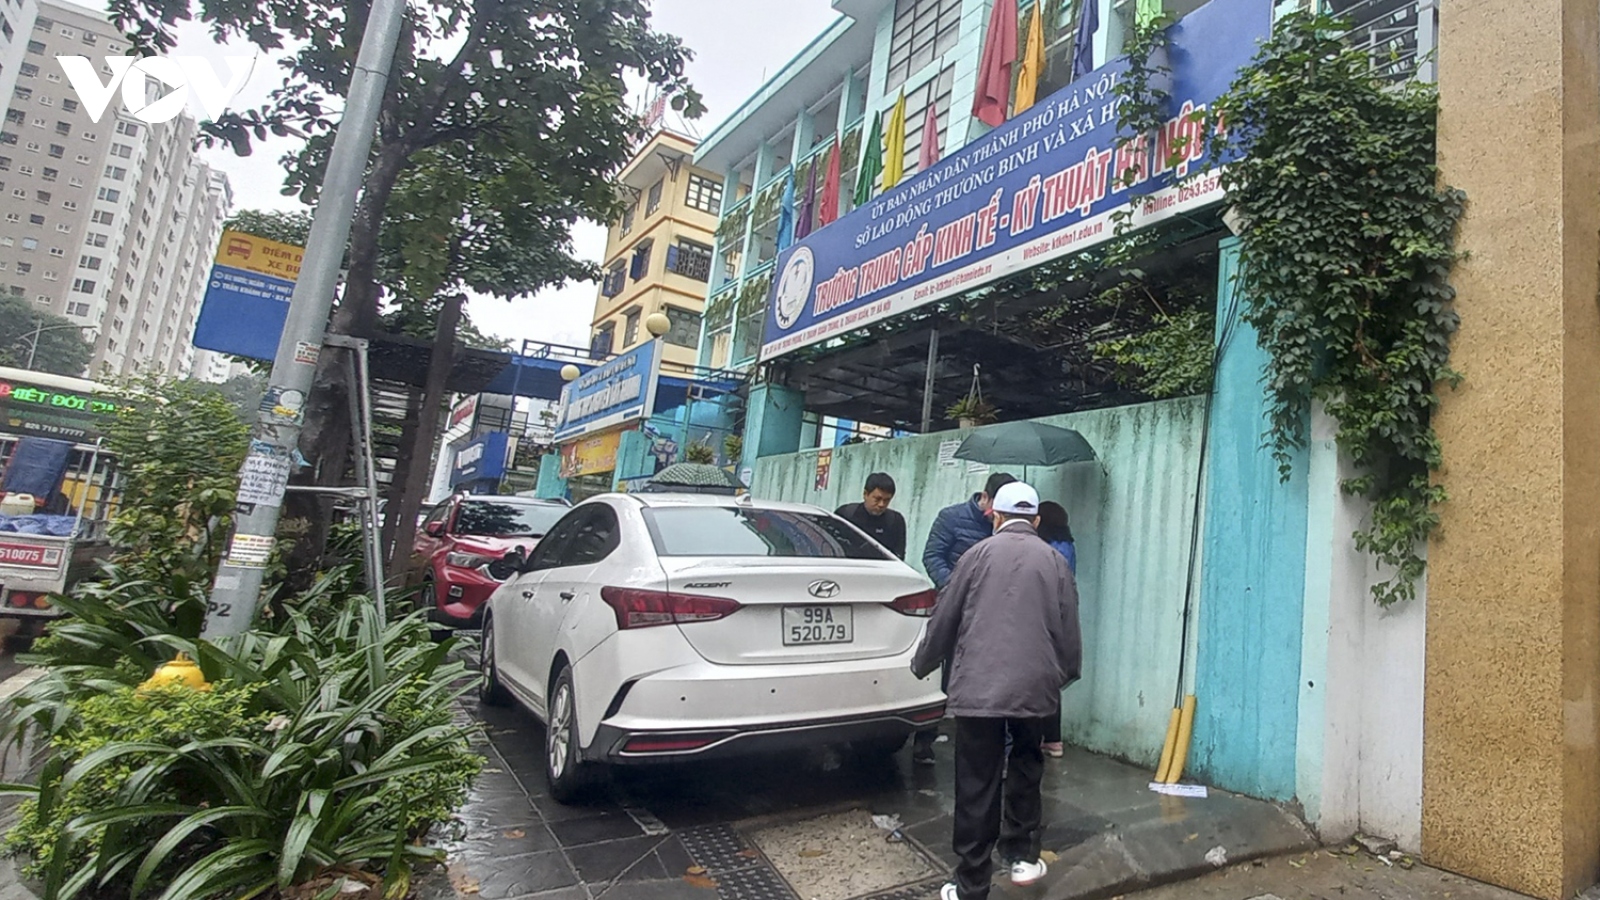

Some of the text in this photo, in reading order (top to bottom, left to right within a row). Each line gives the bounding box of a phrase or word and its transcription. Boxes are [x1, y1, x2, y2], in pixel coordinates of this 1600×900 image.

[871, 72, 1117, 220] ỦY BAN NHÂN DÂN THÀNH PHỐ HÀ NỘI
[855, 224, 872, 249] SỞ
[871, 217, 895, 242] LAO
[895, 198, 932, 229] ĐỘNG
[934, 165, 995, 209] THƯƠNG
[997, 141, 1040, 177] BINH
[1043, 123, 1067, 153] VÀ
[1069, 108, 1096, 141] XÃ
[1178, 175, 1222, 204] 0243.557
[813, 267, 859, 317] TRƯỜNG
[857, 247, 902, 299] TRUNG
[900, 222, 934, 281] CẤP
[931, 211, 976, 268] KINH
[975, 186, 1004, 251] TẾ
[1010, 173, 1041, 237] KỸ
[1042, 146, 1113, 223] THUẬT
[1152, 99, 1206, 178] NỘI
[267, 259, 301, 273] XE BU
[804, 608, 833, 623] 99A
[791, 625, 846, 642] 520.79
